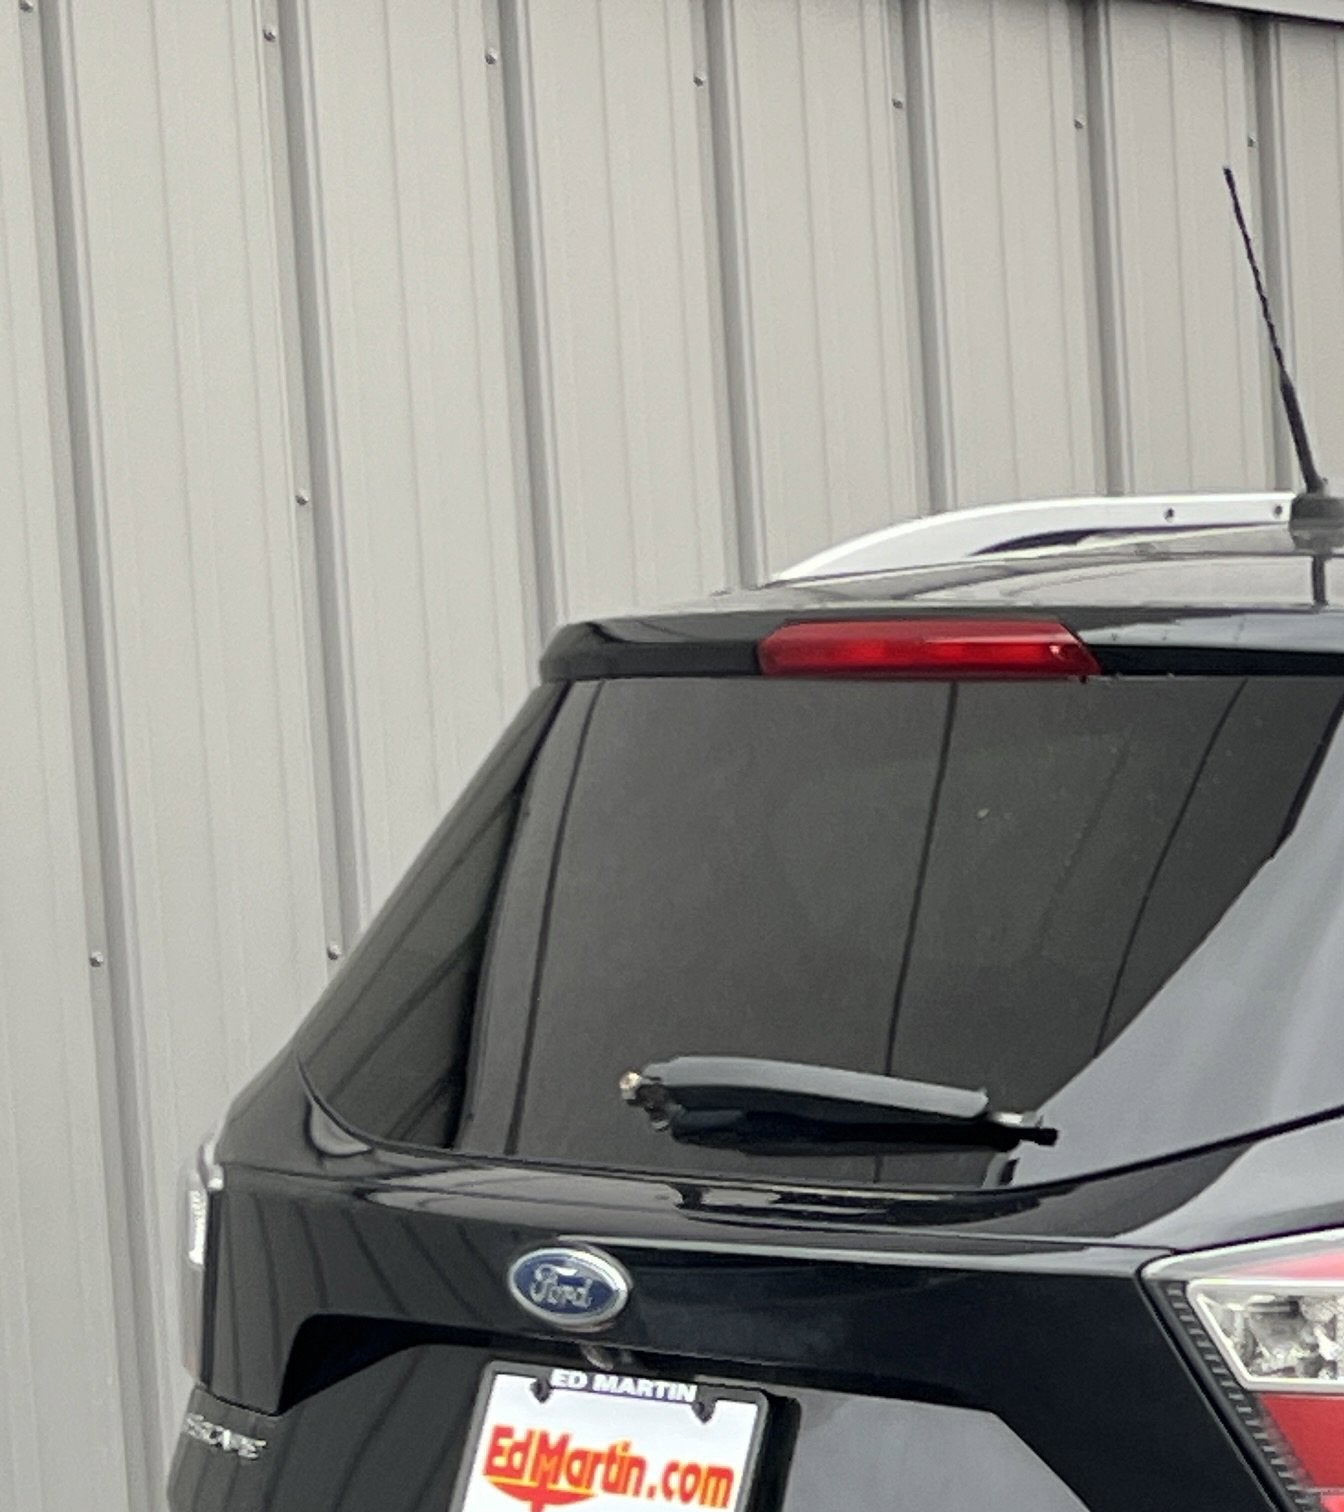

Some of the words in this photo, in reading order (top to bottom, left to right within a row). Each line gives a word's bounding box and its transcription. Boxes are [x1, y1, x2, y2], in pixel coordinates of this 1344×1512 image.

[529, 1263, 593, 1309] Ford
[551, 1369, 588, 1389] ED
[594, 1373, 698, 1402] MARTIN
[482, 1424, 735, 1510] EdMartin.com
